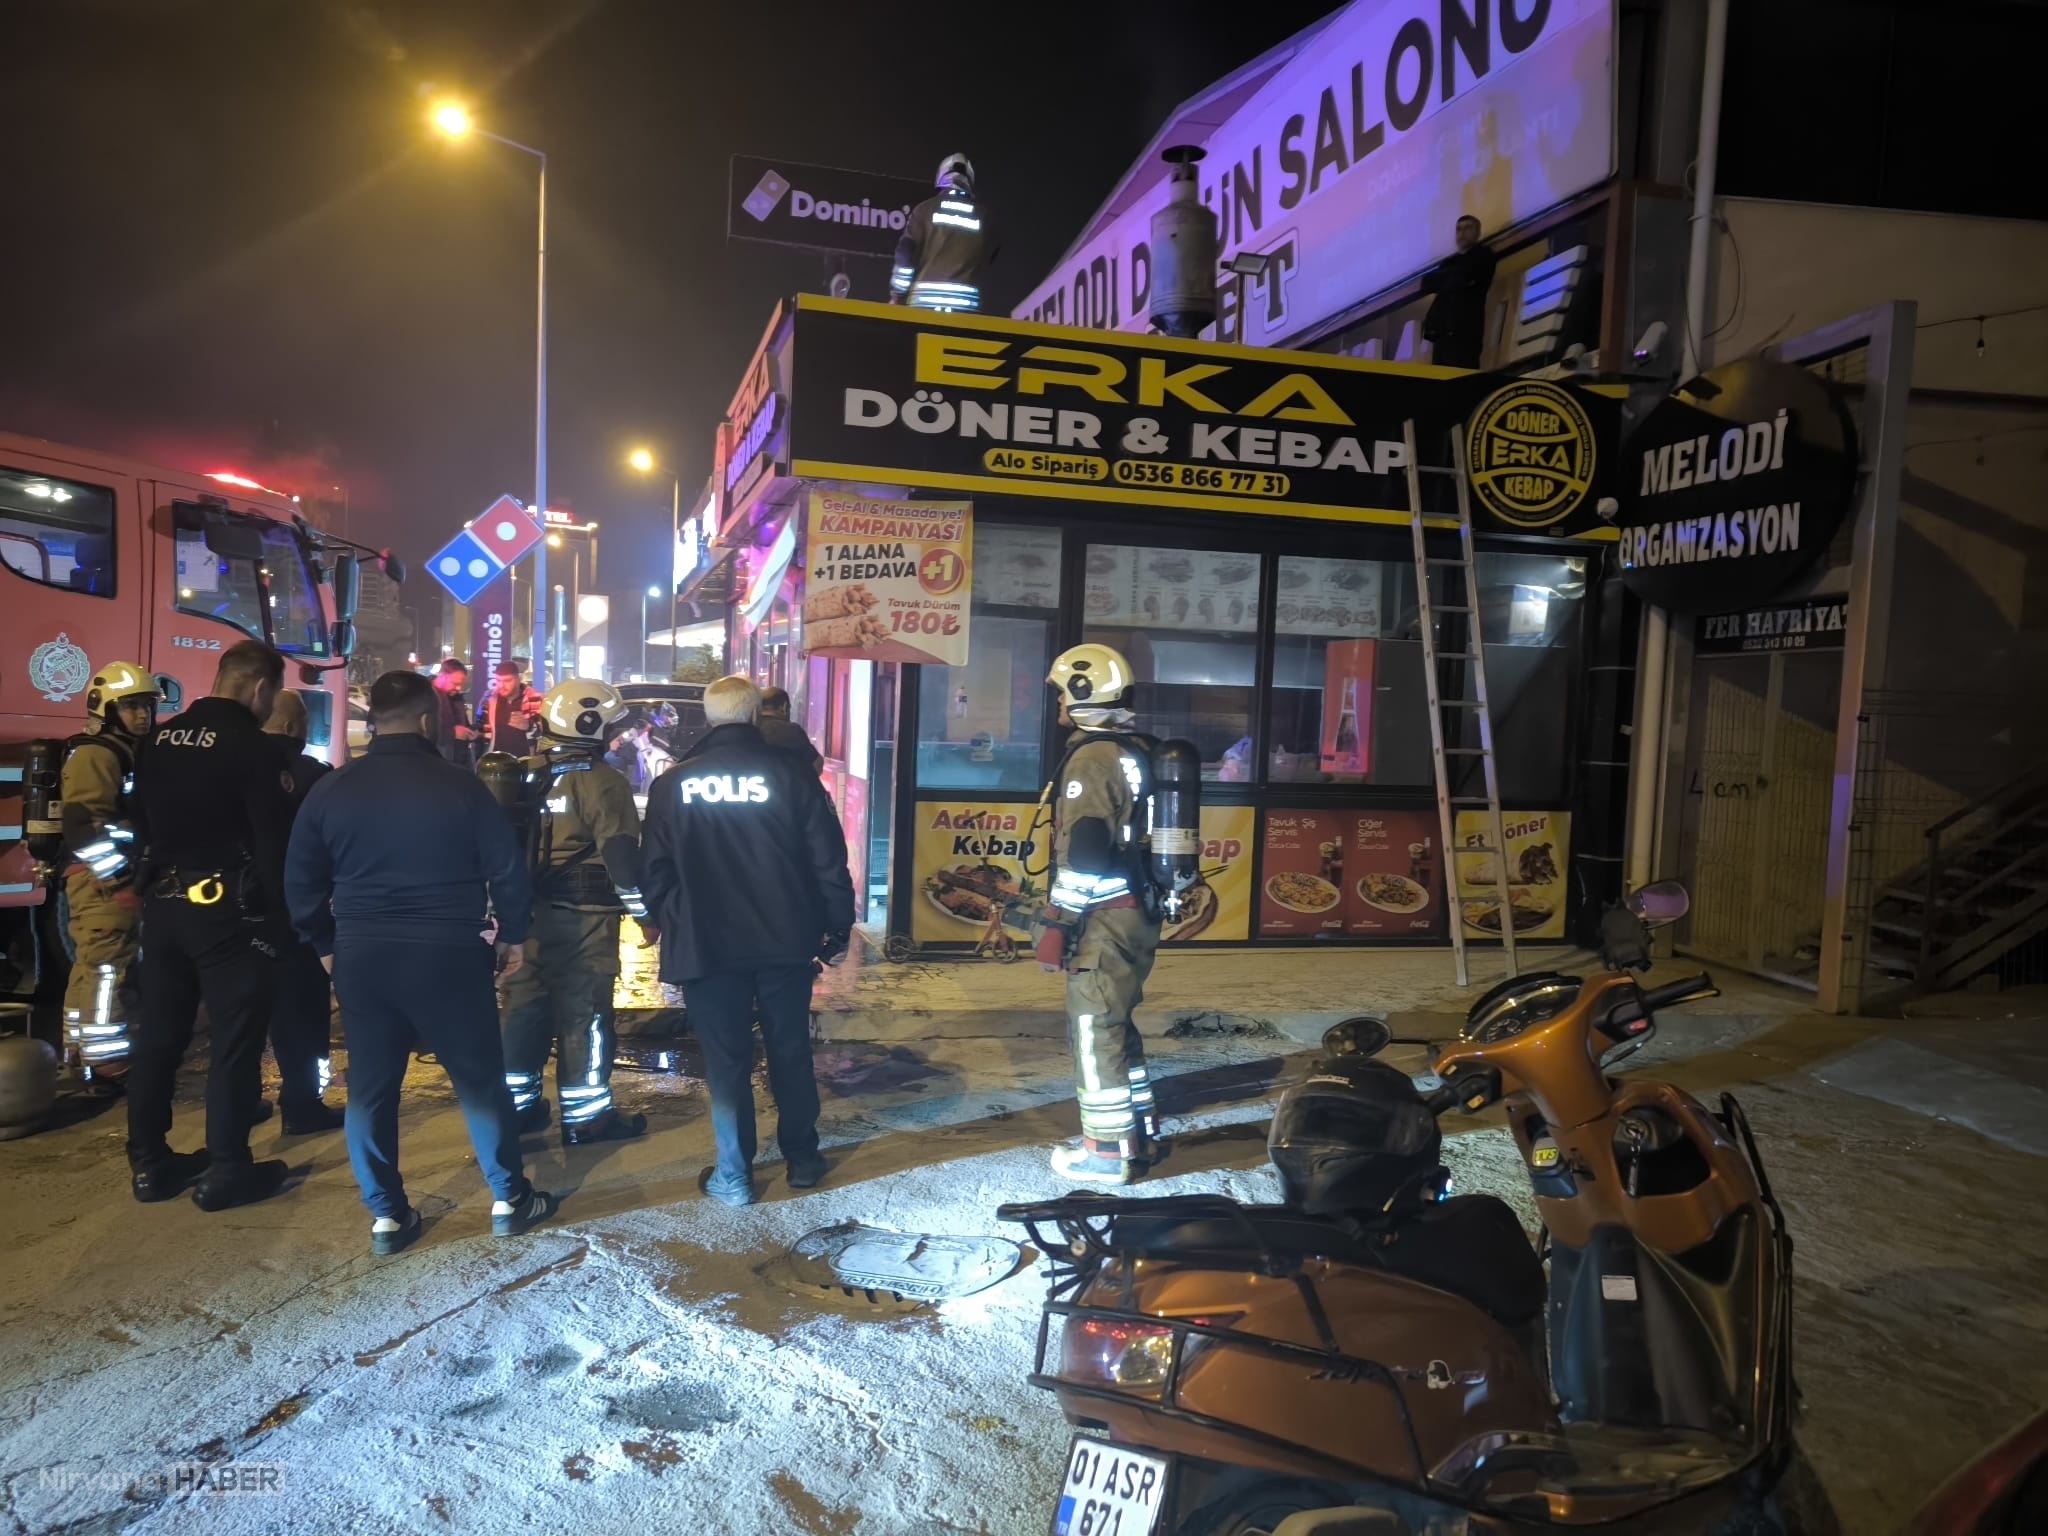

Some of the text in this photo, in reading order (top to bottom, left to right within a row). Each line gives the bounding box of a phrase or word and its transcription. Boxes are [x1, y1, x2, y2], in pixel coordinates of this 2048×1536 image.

[790, 189, 912, 231] Domino'
[915, 332, 1357, 427] ERKA
[843, 387, 1102, 449] DÖNER
[1121, 417, 1169, 455] &
[1191, 422, 1409, 475] KEBAP
[1505, 407, 1561, 434] DÖNER
[1491, 436, 1572, 473] ERKA
[1640, 407, 1789, 497] MELODİ
[991, 452, 1285, 494] Alo Sipariş 0536 866 77 31
[1504, 475, 1555, 500] KEBAP
[869, 504, 882, 515] &
[883, 505, 939, 519] Masada
[939, 509, 965, 523] ye!
[819, 514, 964, 542] KAMPANYASI
[825, 543, 905, 561] 1 ALANA
[814, 562, 917, 580] +1 BEDAVA
[922, 554, 955, 582] +1
[887, 598, 961, 611] Tavuk Dürüm
[890, 610, 961, 636] 180₺
[172, 635, 222, 650] 1832
[486, 613, 503, 690] omino's
[155, 726, 217, 748] POLİS
[1268, 817, 1297, 827] Tavuk
[1268, 828, 1298, 837] Servis
[1357, 829, 1388, 838] Servis
[1504, 817, 1547, 840] öner
[1534, 1148, 1557, 1162] TVS
[1072, 1448, 1156, 1507] 01 ASR
[1079, 1498, 1123, 1536] 671
